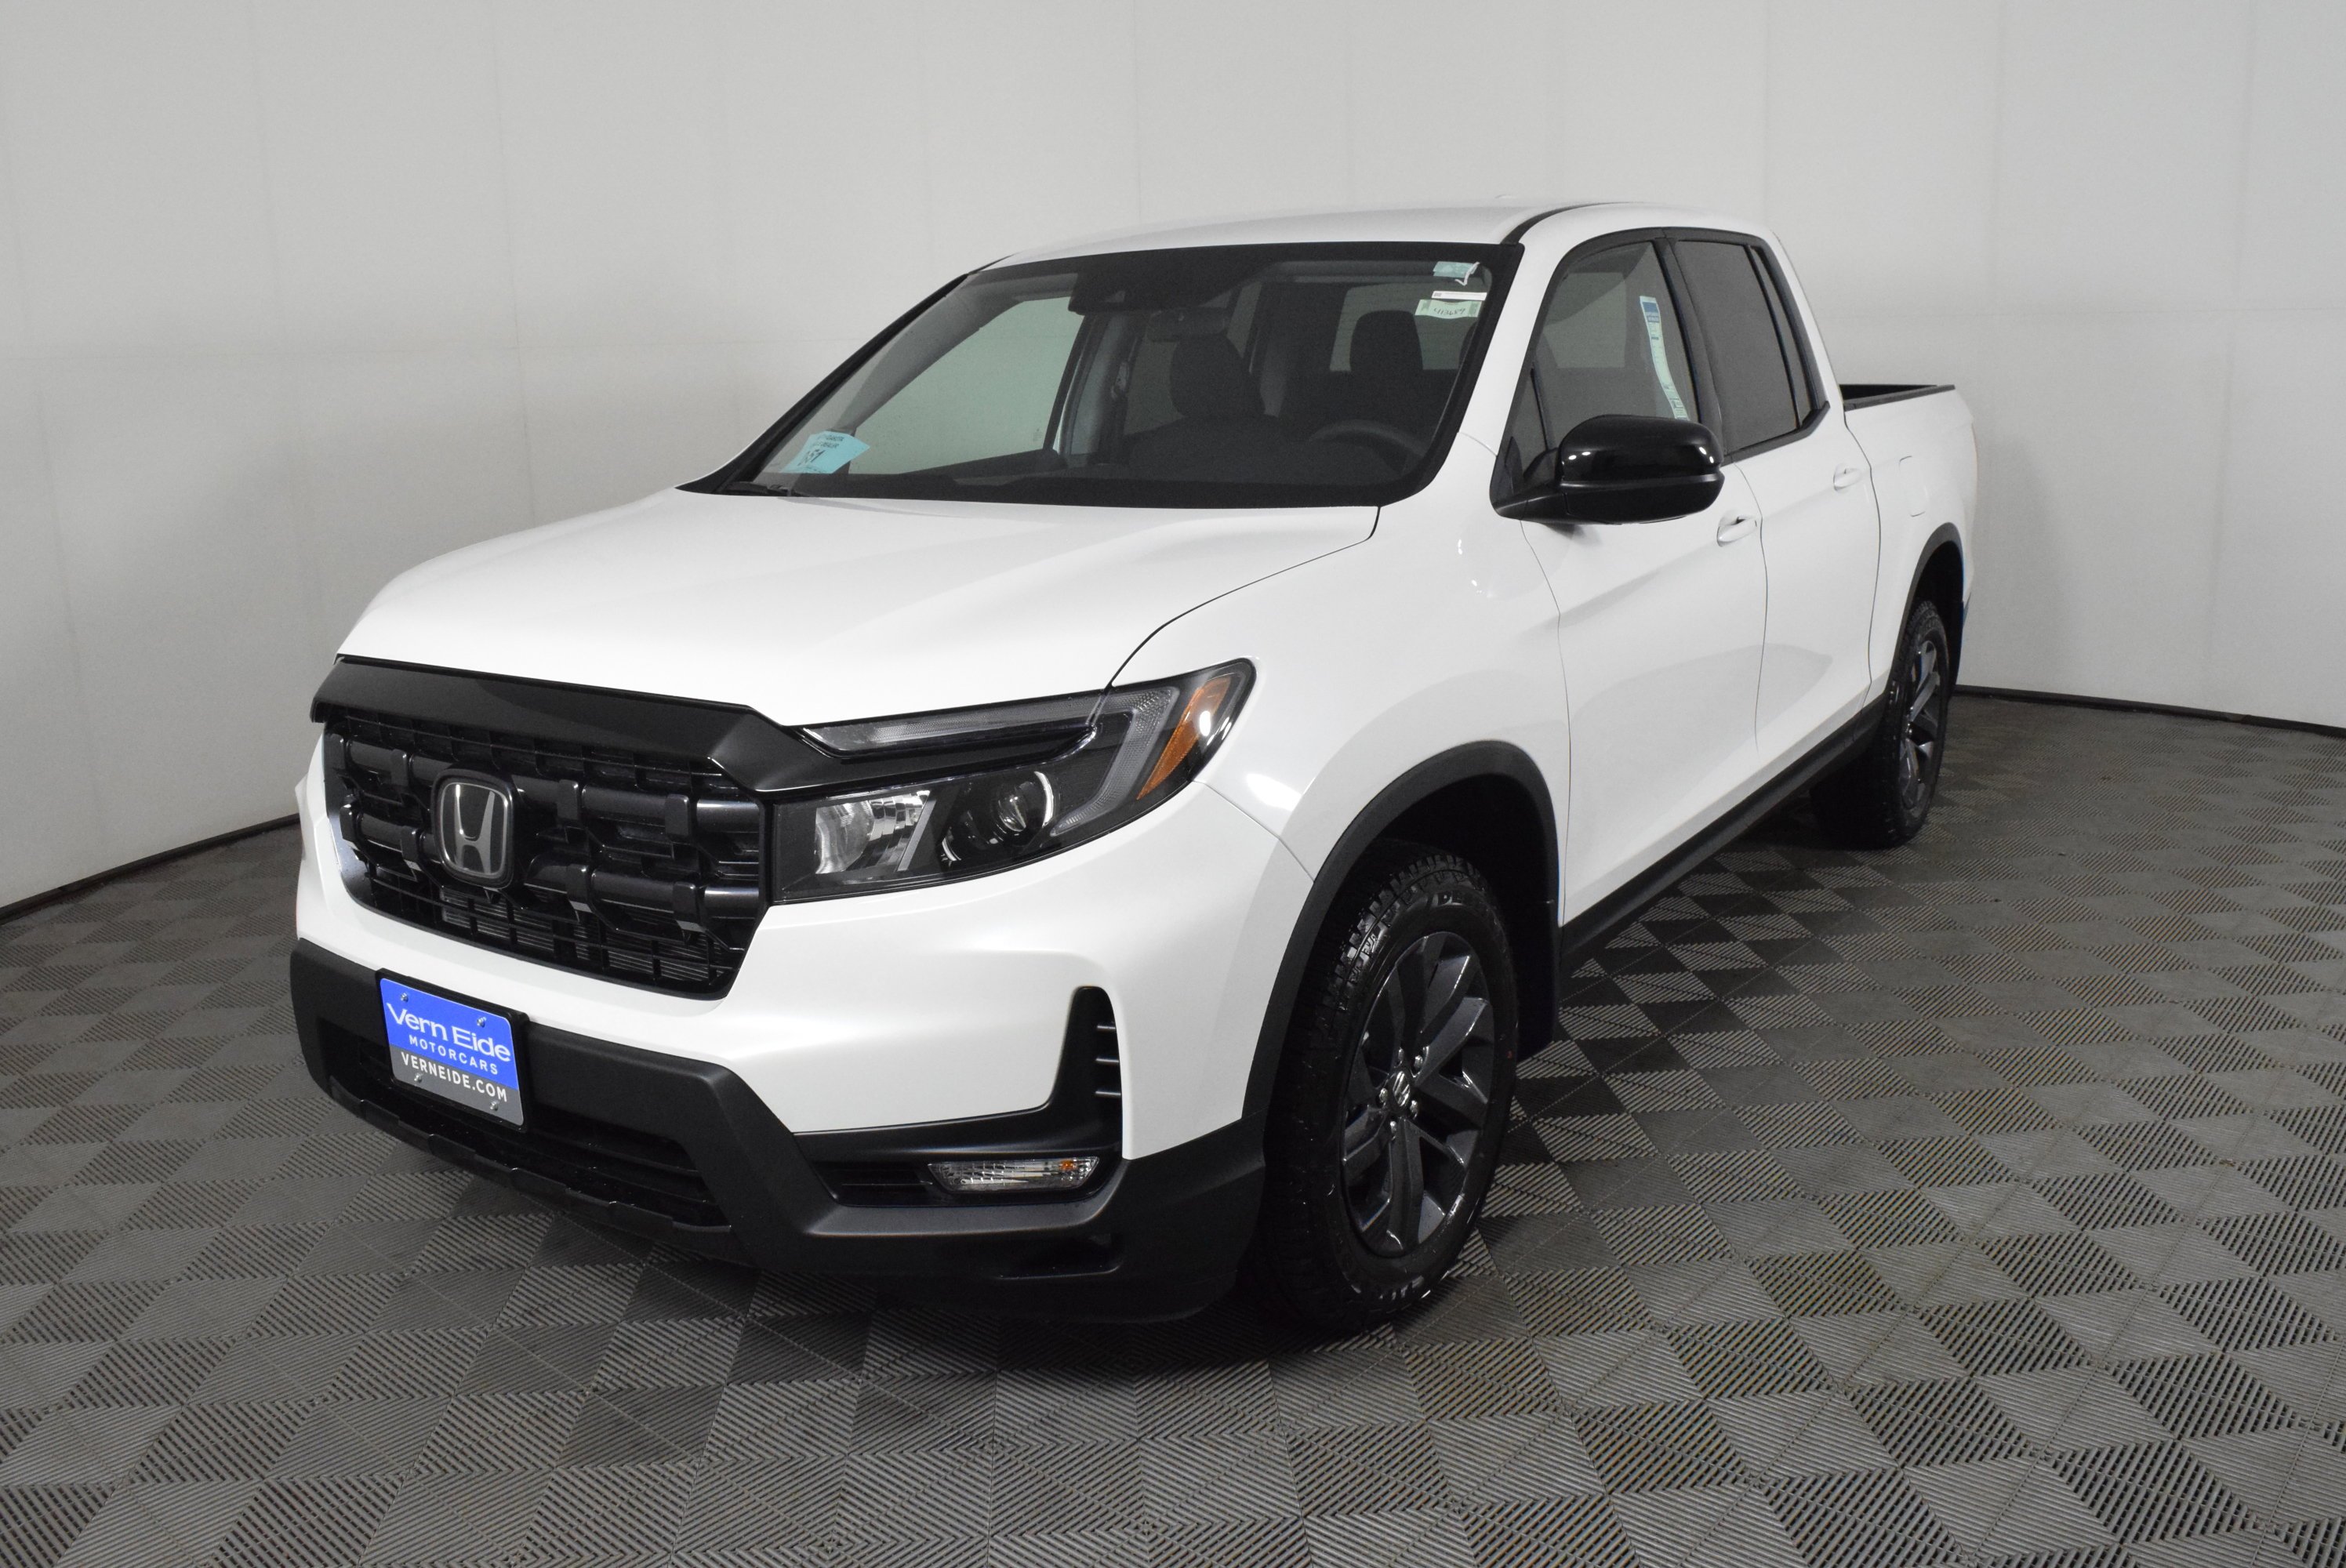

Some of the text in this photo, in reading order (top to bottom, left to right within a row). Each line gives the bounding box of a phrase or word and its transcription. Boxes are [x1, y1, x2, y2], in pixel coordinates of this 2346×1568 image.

[454, 784, 496, 873] H
[387, 1003, 511, 1062] Vern Eide
[409, 1034, 498, 1075] MOTORCARS
[401, 1051, 507, 1102] VERNEIDE.COM
